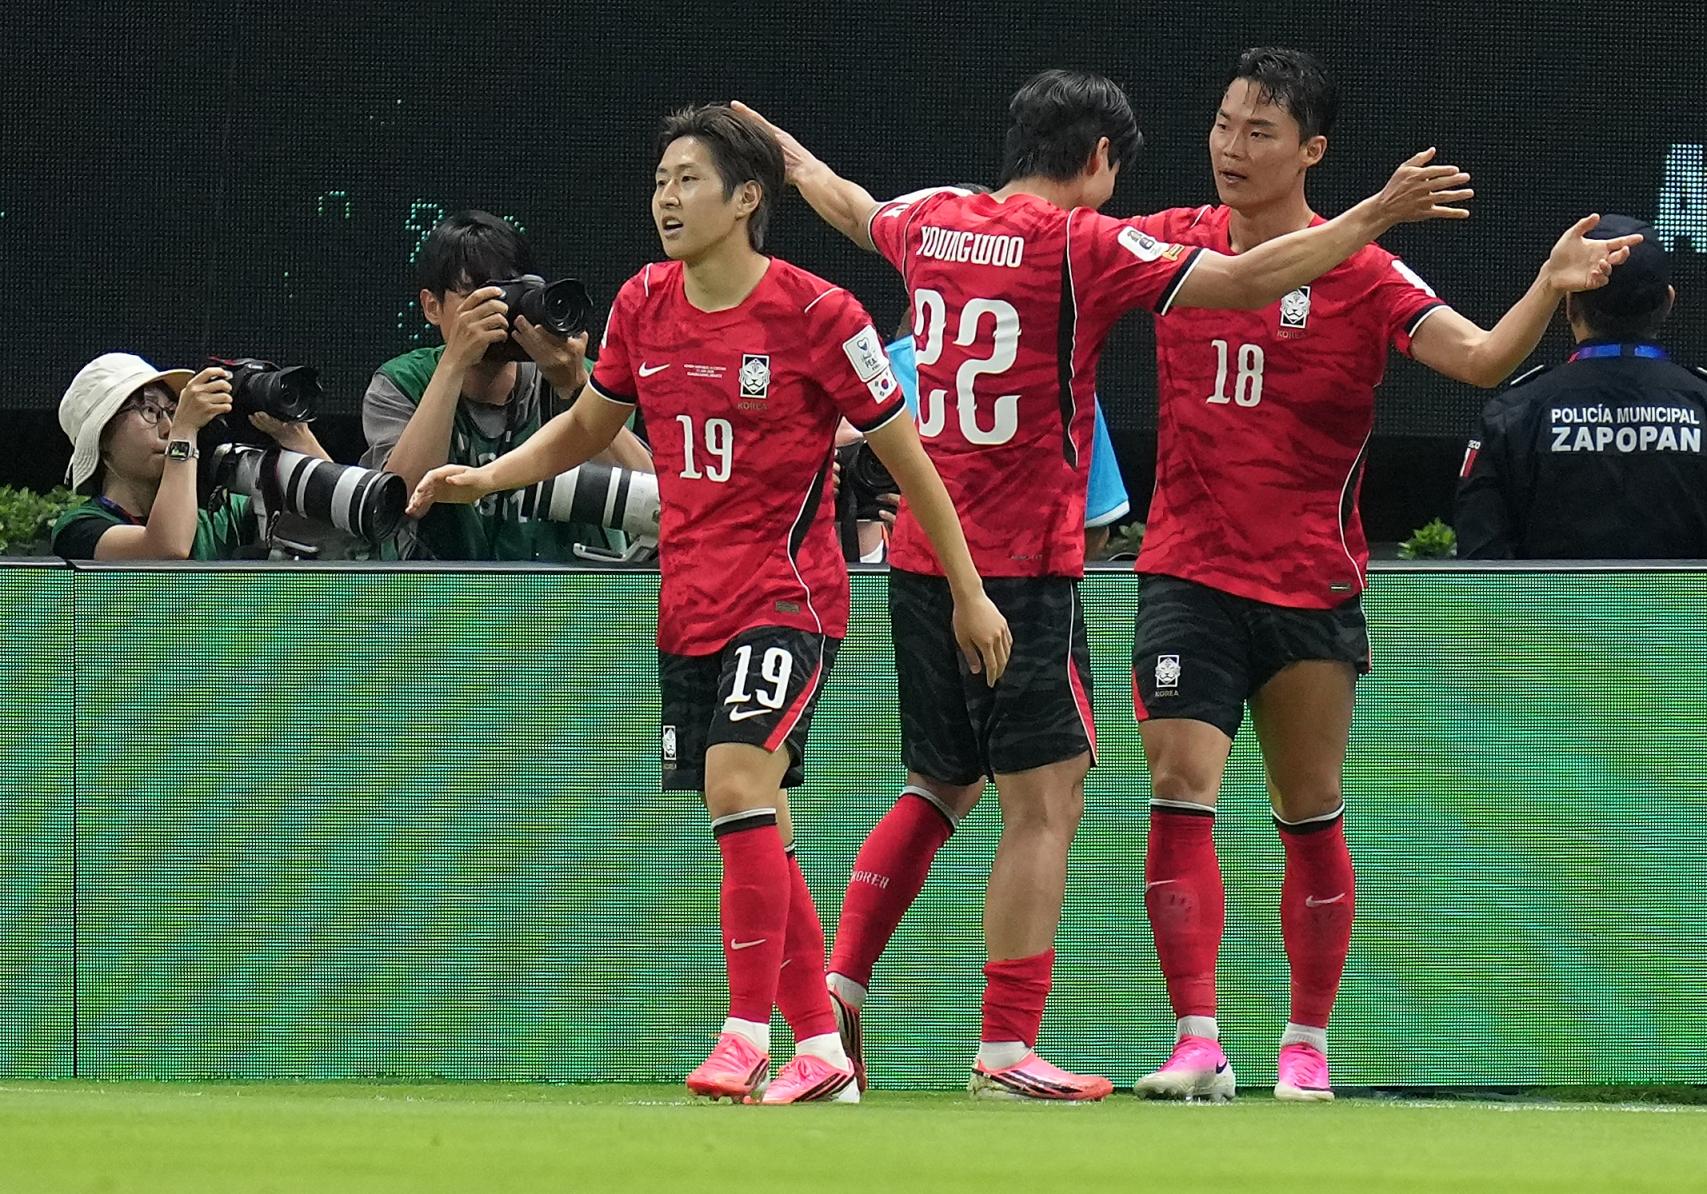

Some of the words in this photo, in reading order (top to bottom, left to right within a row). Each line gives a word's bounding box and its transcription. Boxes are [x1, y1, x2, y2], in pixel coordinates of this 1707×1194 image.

[916, 225, 1025, 268] YOUNGWOO
[914, 287, 1022, 445] 22
[1205, 339, 1265, 408] 18
[1551, 404, 1613, 424] POLICÍA
[1616, 407, 1700, 425] MUNICIPAL
[1551, 425, 1701, 453] ZAPOPAN
[675, 414, 733, 482] 19
[724, 645, 793, 709] 19
